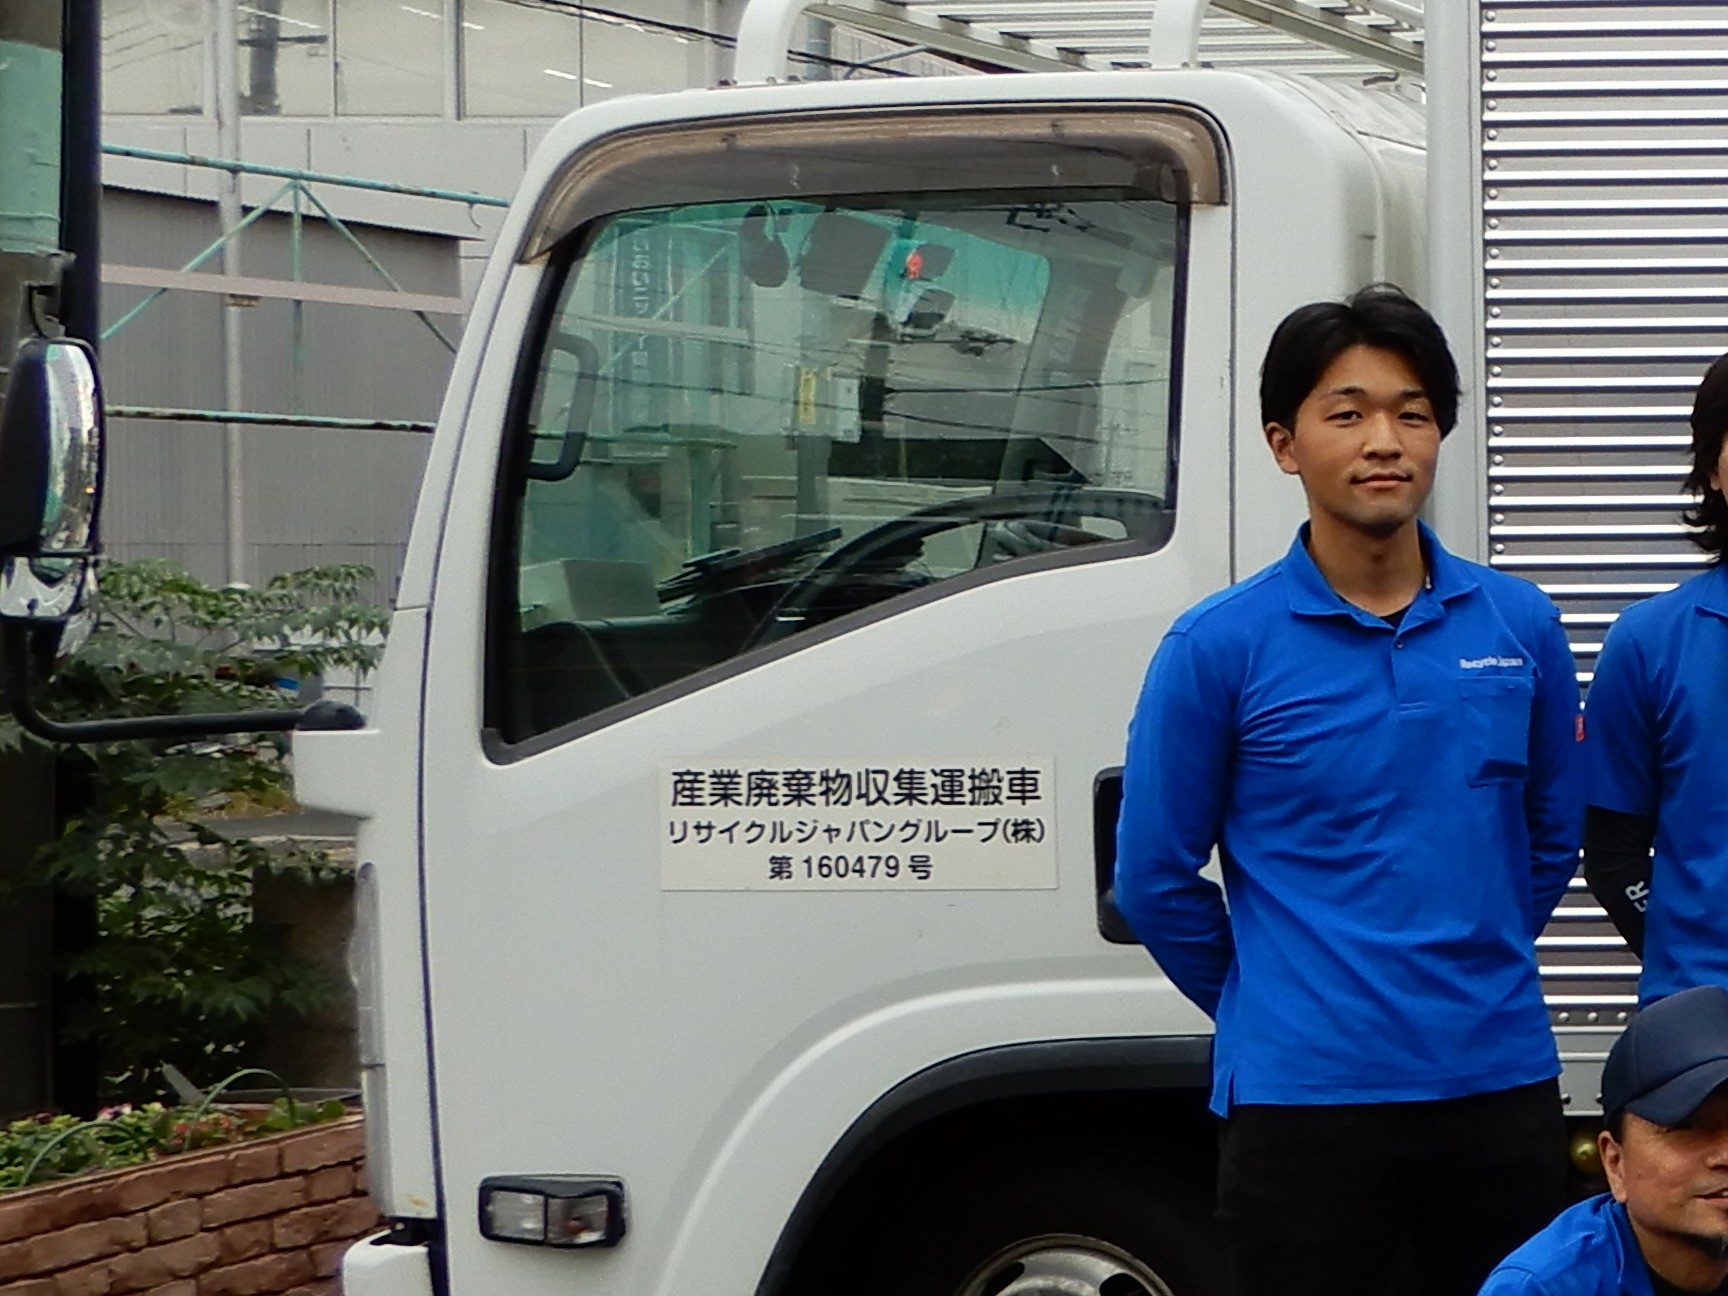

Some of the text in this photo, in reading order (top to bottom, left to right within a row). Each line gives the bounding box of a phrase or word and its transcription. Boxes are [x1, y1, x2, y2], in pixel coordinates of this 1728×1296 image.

[671, 767, 1042, 807] 産業廃棄物収集運搬車
[669, 817, 1046, 844] リサイクルジャパングループ(株)
[768, 854, 934, 880] 第 160479 号
